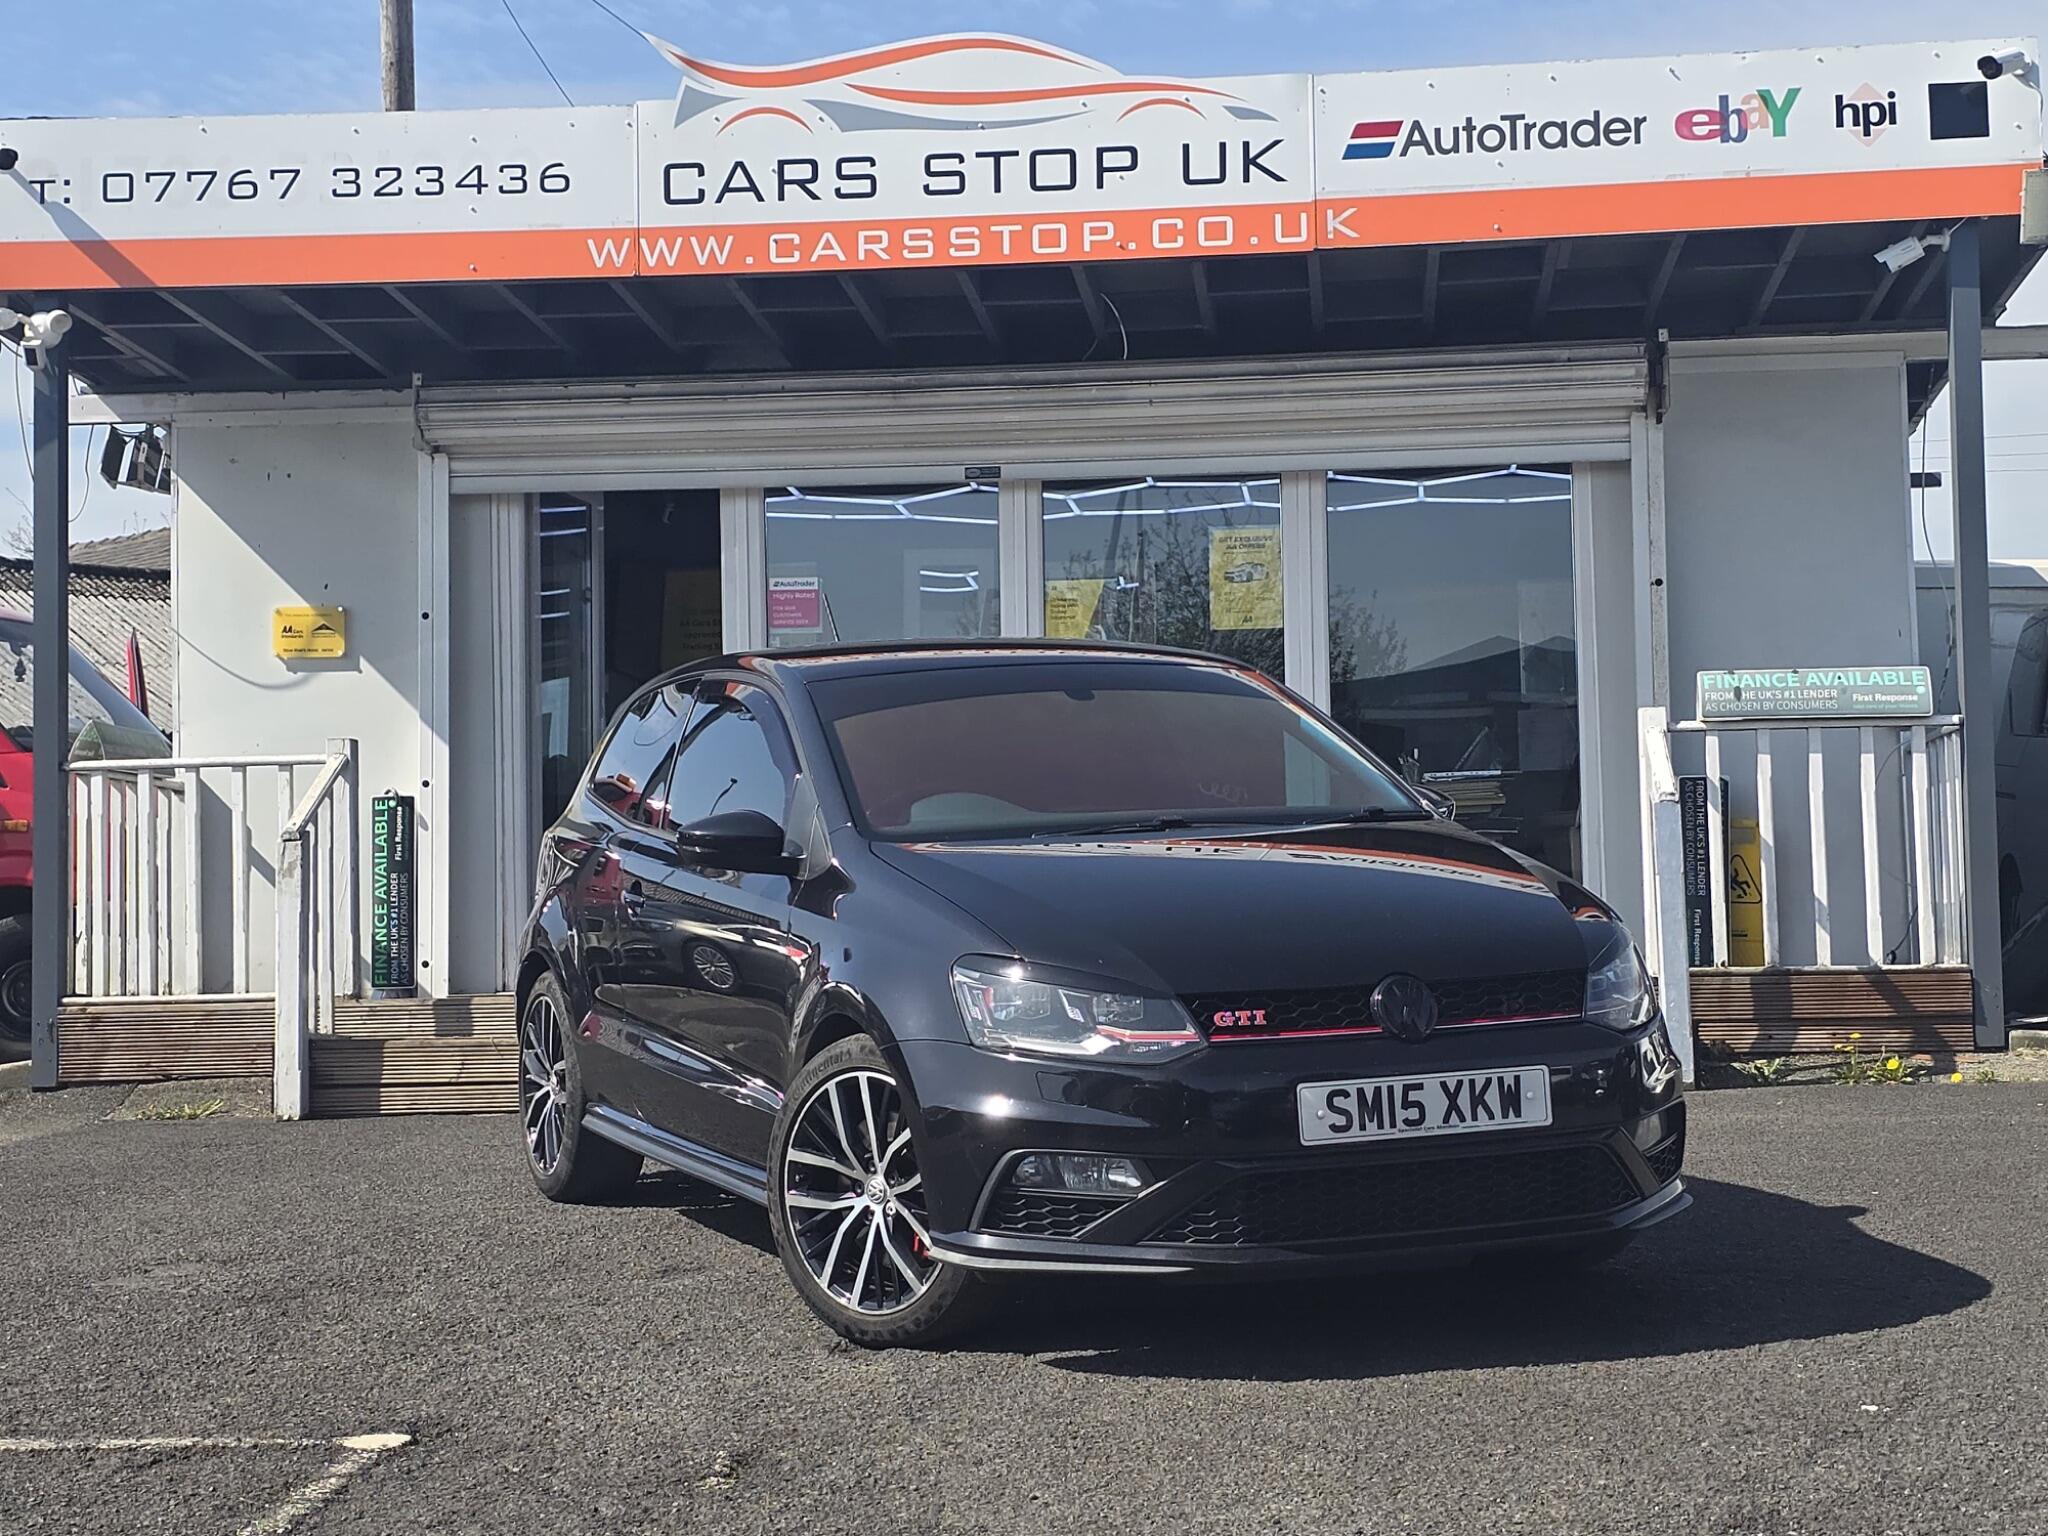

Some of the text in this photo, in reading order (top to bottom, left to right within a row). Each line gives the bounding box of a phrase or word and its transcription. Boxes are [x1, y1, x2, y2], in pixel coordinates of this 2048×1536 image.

[1835, 90, 1898, 130] hpi
[1399, 110, 1648, 158] AutoTrader
[30, 161, 571, 206] T: 07767 323436
[662, 138, 1288, 205] CARS STOP UK
[586, 206, 1362, 269] WWW.CARSSTOP.CO.UK
[282, 625, 293, 634] AA
[1703, 670, 1926, 689] FINANCE AVAILABLE
[1705, 688, 1838, 701] FROM HE UK'S #1 LENDER
[1705, 700, 1838, 712] AS CHOSEN BY CONSUMERS
[1852, 693, 1918, 703] First Response
[1696, 780, 1705, 805] FROM
[395, 806, 403, 842] Response
[1685, 793, 1694, 828] CHOSEN
[1696, 808, 1705, 825] THE
[1686, 830, 1695, 840] BY
[1686, 842, 1695, 896] CONSUMERS
[1697, 861, 1706, 896] LENDER
[375, 799, 388, 985] FINANCE AVAILABLE
[390, 872, 398, 907] LENDER
[400, 872, 409, 924] CONSUMERS
[390, 919, 399, 940] UK'S
[400, 926, 409, 937] BY
[1693, 909, 1702, 966] First Response
[390, 941, 399, 958] THE
[400, 938, 409, 972] CHOSEN
[390, 960, 399, 984] FROM
[1213, 1009, 1267, 1028] GTI
[1325, 1074, 1522, 1134] SM15 XKW
